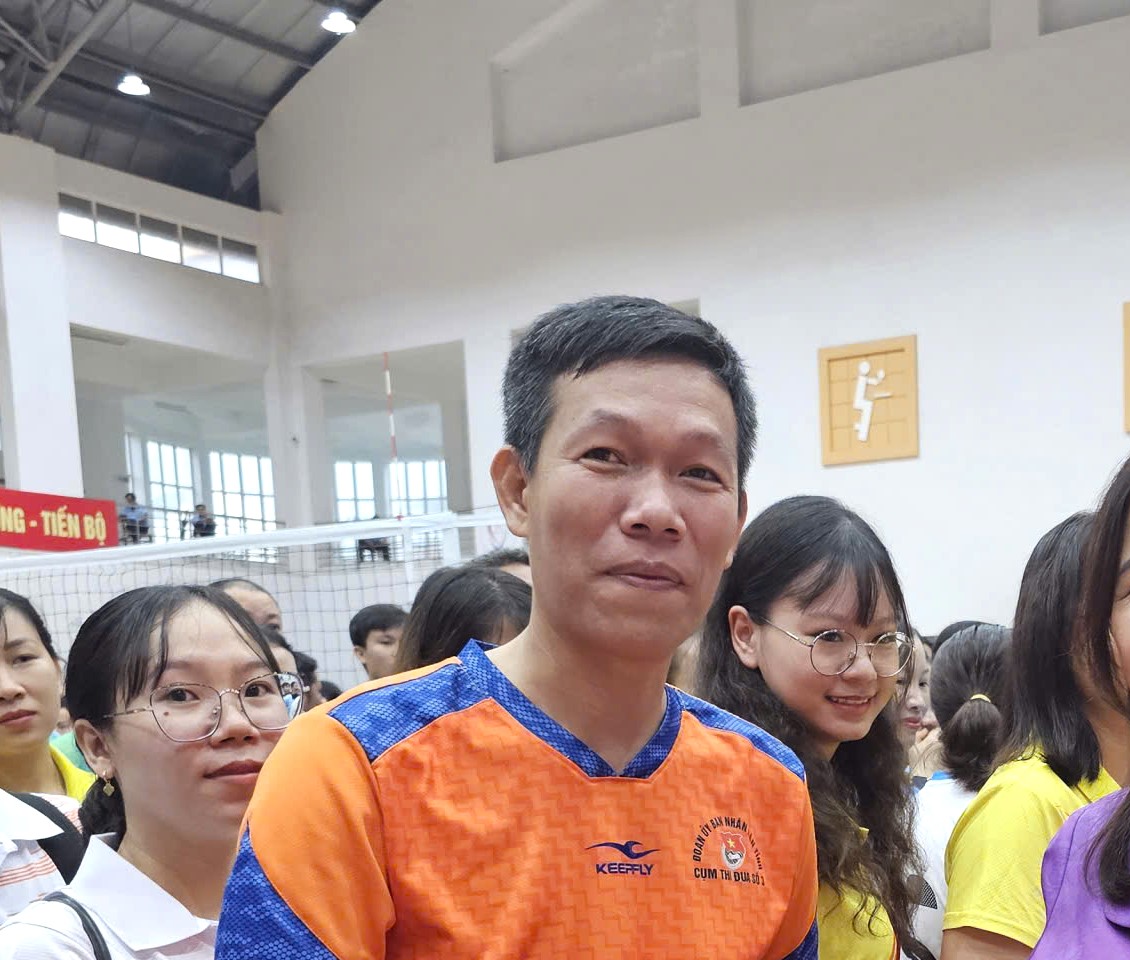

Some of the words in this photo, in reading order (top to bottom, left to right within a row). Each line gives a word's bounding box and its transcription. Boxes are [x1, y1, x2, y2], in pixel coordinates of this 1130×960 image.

[0, 506, 26, 534] NG
[40, 505, 81, 539] TIẾN
[83, 511, 107, 546] BỘ
